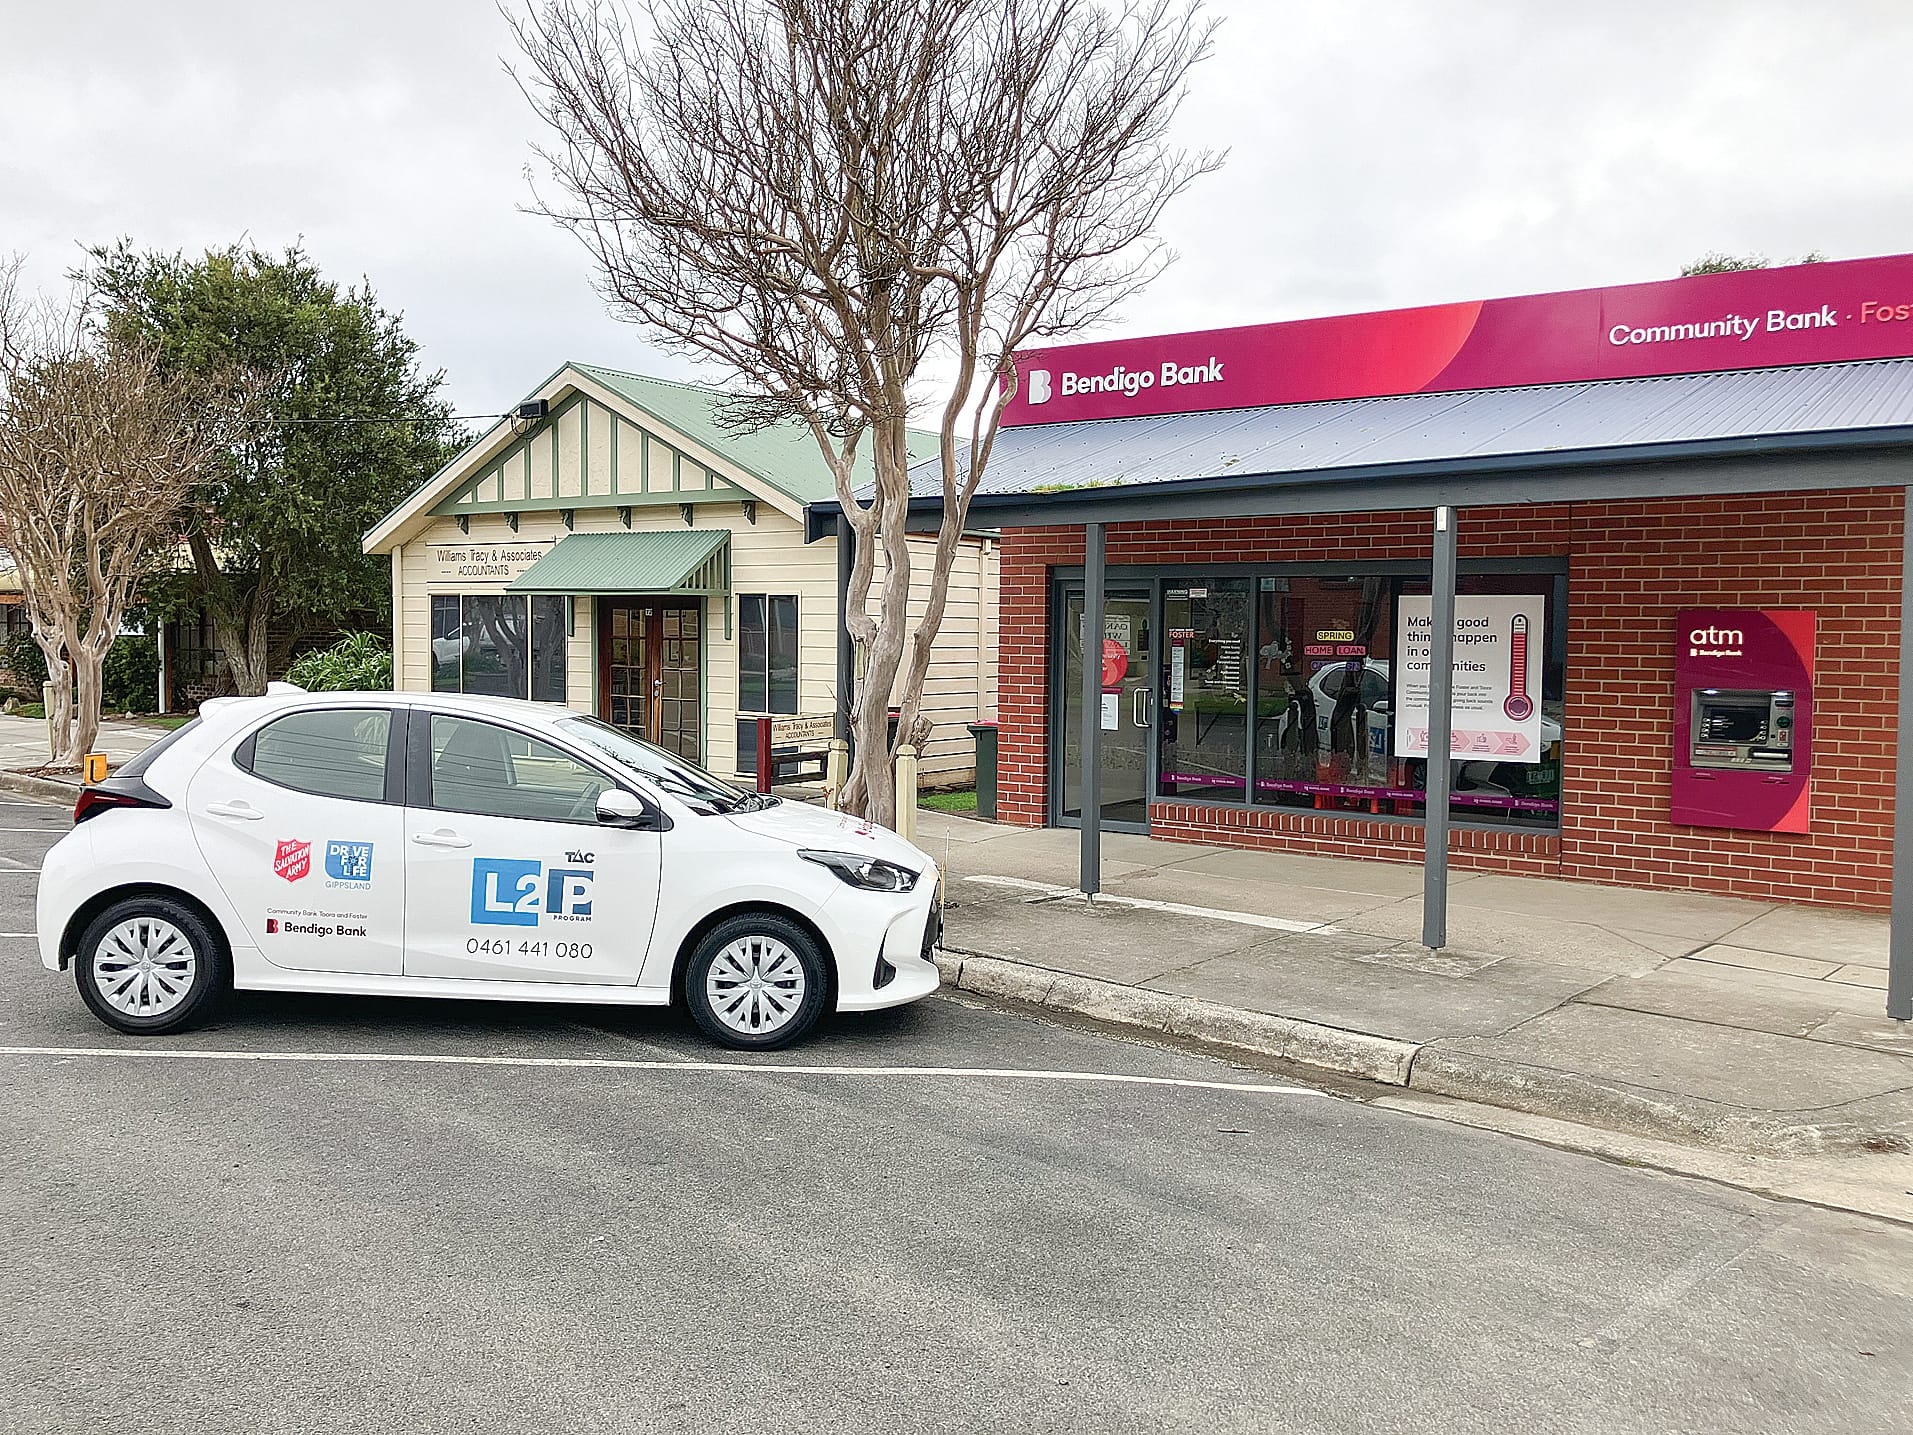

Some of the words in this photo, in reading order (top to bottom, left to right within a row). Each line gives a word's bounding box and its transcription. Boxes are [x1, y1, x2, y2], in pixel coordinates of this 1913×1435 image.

[1609, 313, 1760, 345] Community
[1766, 304, 1837, 333] Bank
[1061, 366, 1154, 397] Bendigo
[1161, 356, 1224, 386] Bank
[437, 549, 466, 562] Williams
[469, 549, 489, 564] Tracy
[491, 549, 497, 561] &
[501, 548, 543, 561] Associates
[458, 564, 509, 576] ACCOUNTANTS
[1407, 616, 1432, 627] Mak
[1457, 616, 1489, 630] good
[1318, 631, 1352, 640] SPRING
[1407, 631, 1431, 642] thin
[1690, 625, 1743, 645] atm
[1305, 646, 1332, 655] HOME
[1338, 646, 1364, 655] LOAN
[1407, 646, 1418, 656] in
[280, 841, 297, 857] THE
[564, 849, 595, 864] TAC
[274, 844, 310, 872] SALVATION
[285, 858, 307, 879] ARMY
[325, 880, 372, 890] GIPPSLAND
[266, 907, 302, 917] Community
[302, 909, 317, 917] Bank
[553, 914, 592, 922] PROGRAM
[284, 921, 333, 937] Bendigo
[336, 925, 367, 937] Bank
[466, 938, 510, 955] 0461
[518, 940, 548, 957] 441
[555, 942, 593, 959] 080
